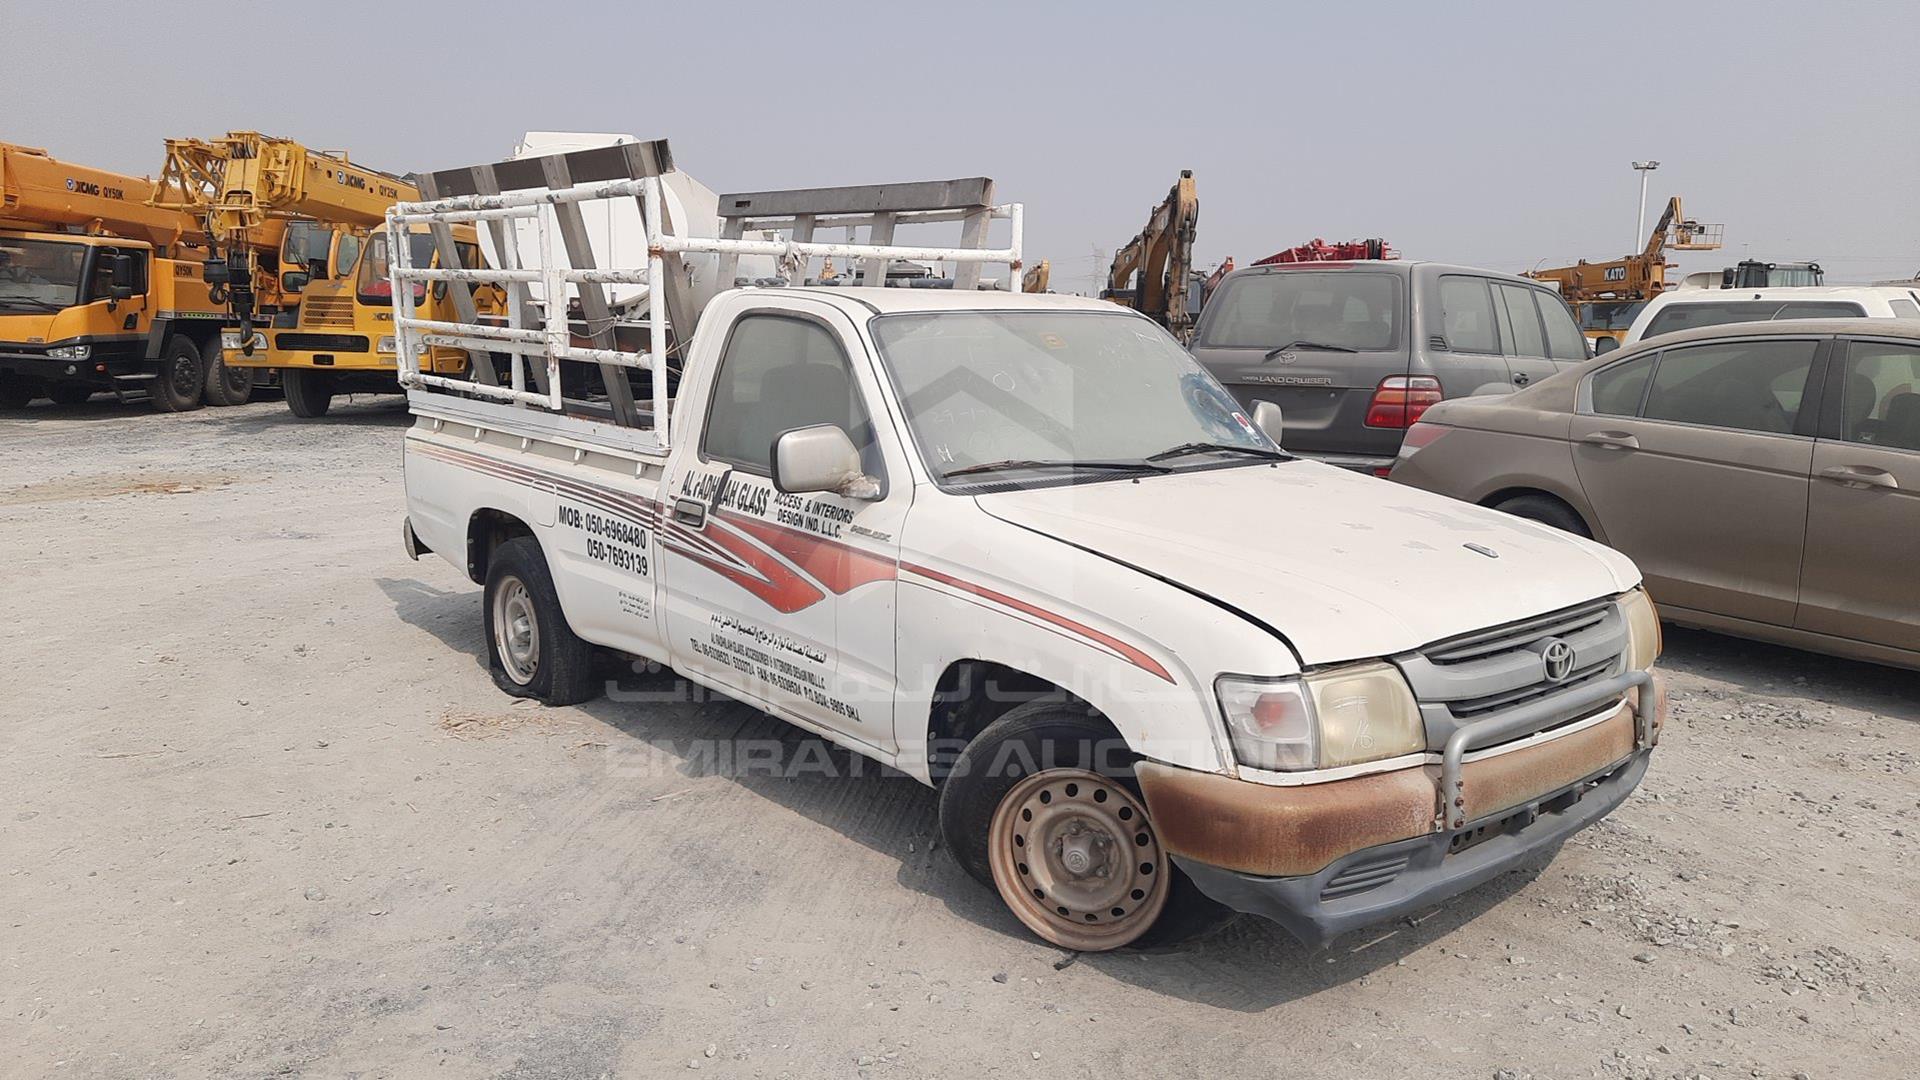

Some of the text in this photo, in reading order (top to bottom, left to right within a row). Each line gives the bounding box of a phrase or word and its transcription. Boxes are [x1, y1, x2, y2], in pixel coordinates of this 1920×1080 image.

[75, 181, 124, 201] XCMG QY50K
[345, 174, 366, 190] XCMG
[175, 264, 193, 277] QY50K
[1604, 266, 1625, 281] KATO
[1259, 375, 1285, 383] LAND
[1285, 377, 1332, 385] CRUISER
[681, 470, 695, 498] AL
[737, 483, 771, 517] GLASS
[774, 492, 855, 525] ACCESS & INTERIORS
[558, 505, 646, 550] MOB: 050-6968480
[776, 511, 804, 528] DESIGN
[804, 516, 820, 534] IND.
[820, 520, 842, 539] L.L.C.
[587, 538, 648, 576] 050-7693139
